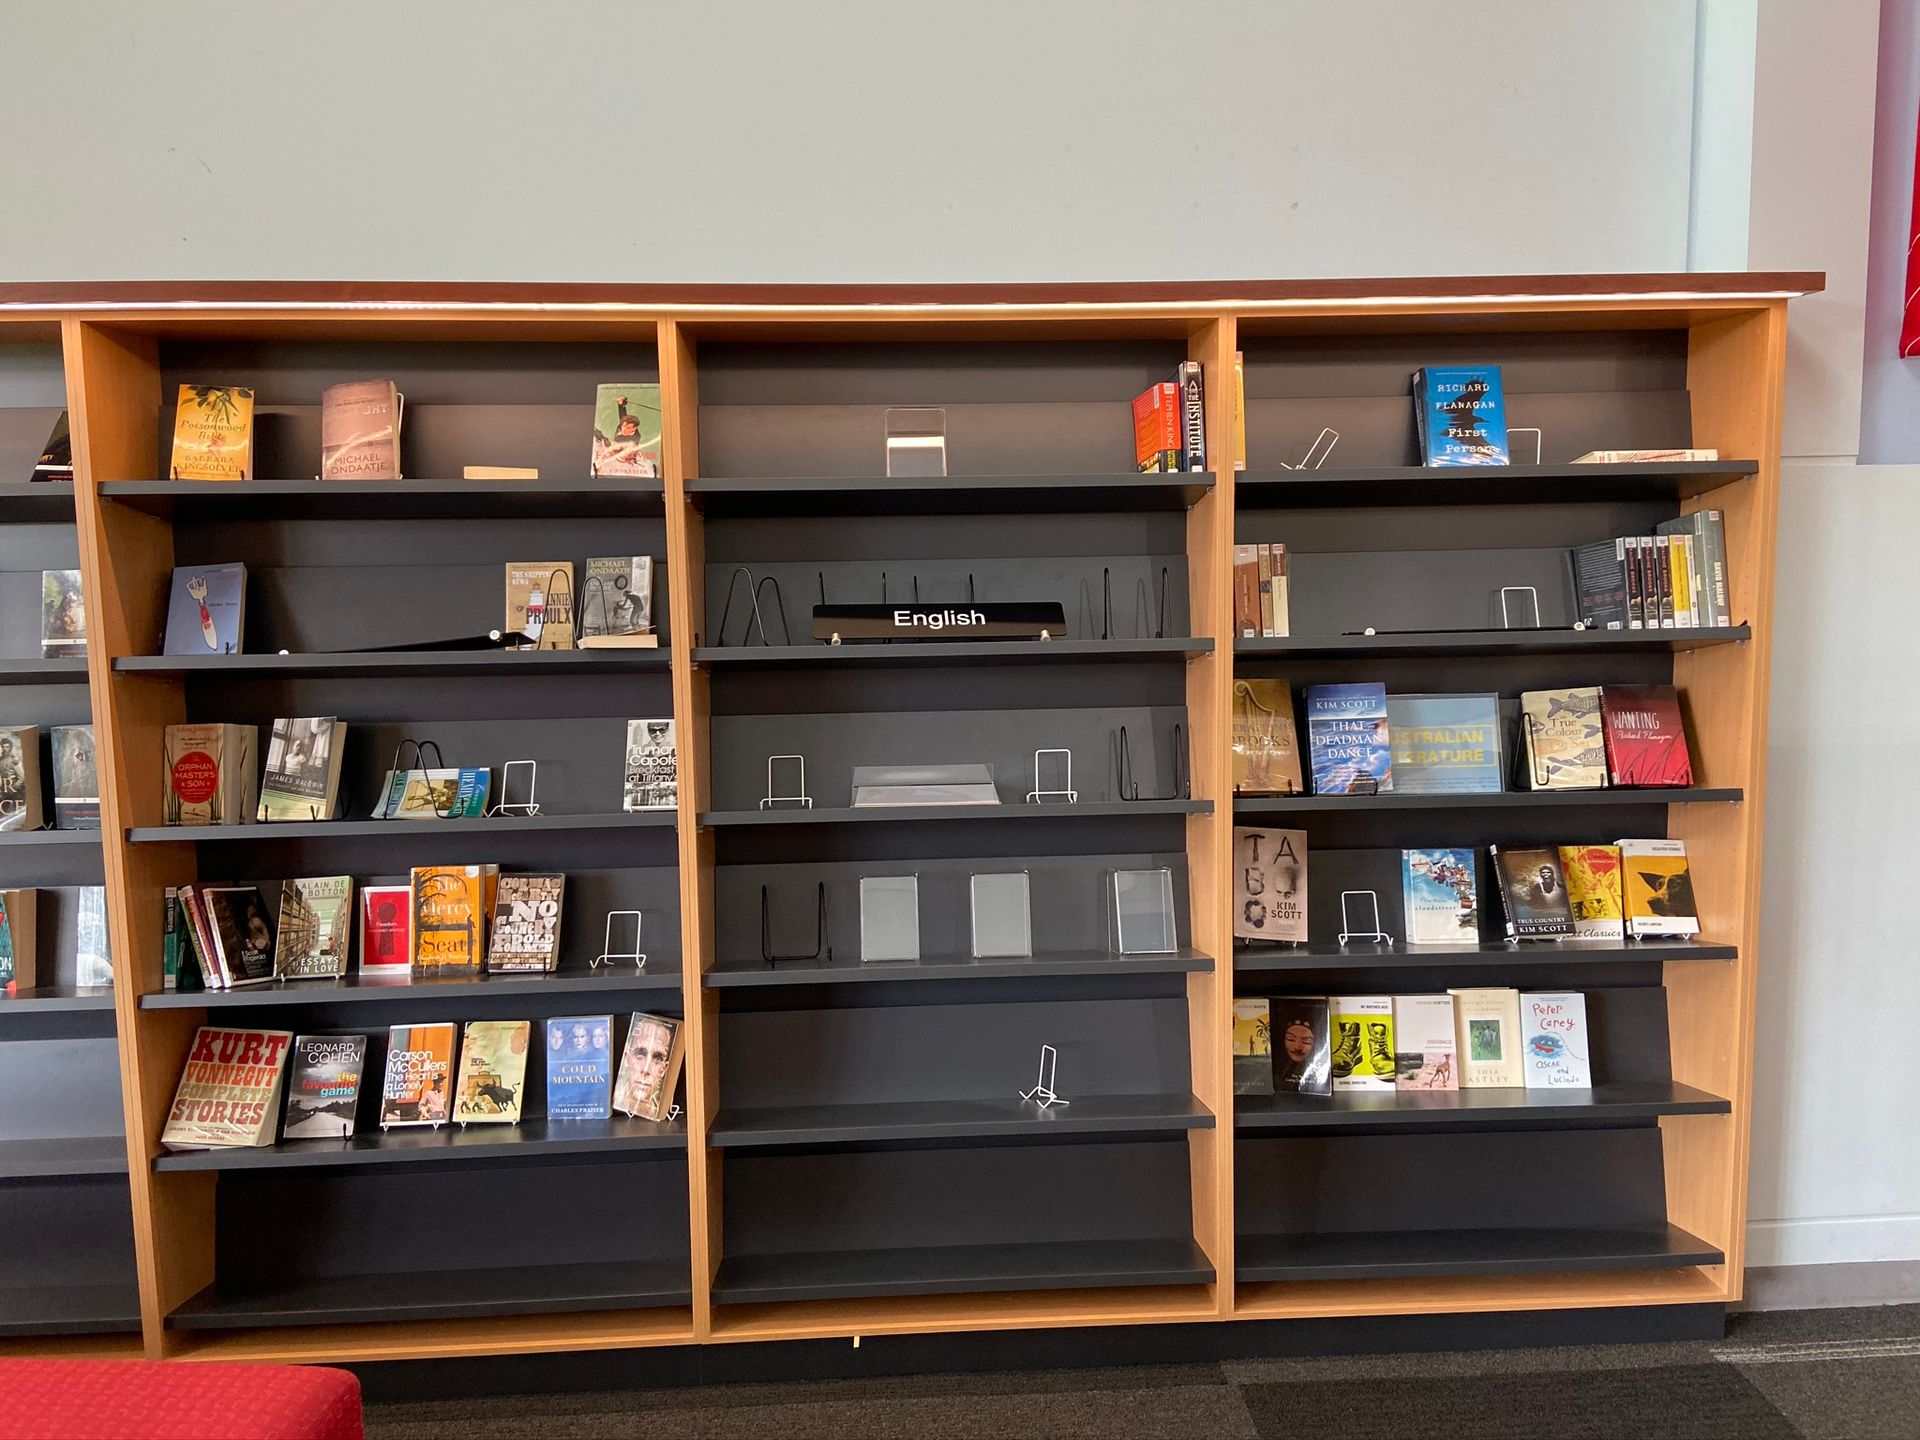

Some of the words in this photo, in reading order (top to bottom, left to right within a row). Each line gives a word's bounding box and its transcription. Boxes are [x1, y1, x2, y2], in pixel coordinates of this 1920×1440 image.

[1437, 383, 1490, 393] RICHARD
[1165, 394, 1174, 426] TEPHEN
[1435, 401, 1495, 410] FLANAGAN
[181, 420, 247, 432] Poisonwood
[1186, 400, 1204, 458] INSTITUTE
[1167, 427, 1175, 448] KING
[1448, 428, 1489, 438] First
[1445, 444, 1493, 454] Person
[335, 454, 381, 465] MICHAEL
[331, 462, 386, 475] ONDAATJE
[526, 607, 571, 624] PROULX
[893, 610, 986, 630] English
[1316, 702, 1338, 710] KIM
[1341, 699, 1377, 709] SCOTT
[1551, 718, 1577, 728] True
[1612, 711, 1660, 730] WANTING
[1330, 721, 1366, 731] THAT
[1316, 734, 1383, 745] DEADMAN
[1328, 747, 1373, 759] DANCE
[178, 763, 213, 771] ORPHAN
[629, 766, 675, 774] Breakfast
[175, 771, 216, 780] MASTER'S
[271, 775, 293, 784] JAMES
[628, 774, 641, 783] at
[187, 780, 206, 788] SON
[301, 882, 330, 890] ALAIN
[308, 889, 345, 897] BOTTON
[509, 900, 558, 922] NO
[1276, 902, 1297, 911] KIM
[1271, 910, 1302, 919] SCOTT
[1538, 924, 1567, 932] SCOTT
[1584, 929, 1621, 938] Classics
[423, 934, 467, 953] Seat
[301, 956, 339, 966] ESSAYS
[300, 966, 310, 974] IN
[315, 964, 338, 973] LOVE
[1533, 1003, 1562, 1016] Peter
[1540, 1018, 1575, 1031] Carey
[191, 1030, 288, 1066] KURT
[300, 1042, 354, 1052] LEONARD
[308, 1051, 360, 1064] COHEN
[390, 1050, 433, 1062] Carson
[389, 1060, 447, 1072] McCullers
[562, 1065, 597, 1074] COLD
[185, 1062, 279, 1087] VONNEGUT
[336, 1072, 357, 1082] the
[388, 1073, 404, 1081] The
[552, 1076, 605, 1085] MOUNTAIN
[394, 1081, 424, 1091] Lonely
[178, 1083, 272, 1103] COMPLETE
[320, 1086, 355, 1098] game
[385, 1090, 415, 1100] Hunter
[170, 1099, 265, 1125] STORIES
